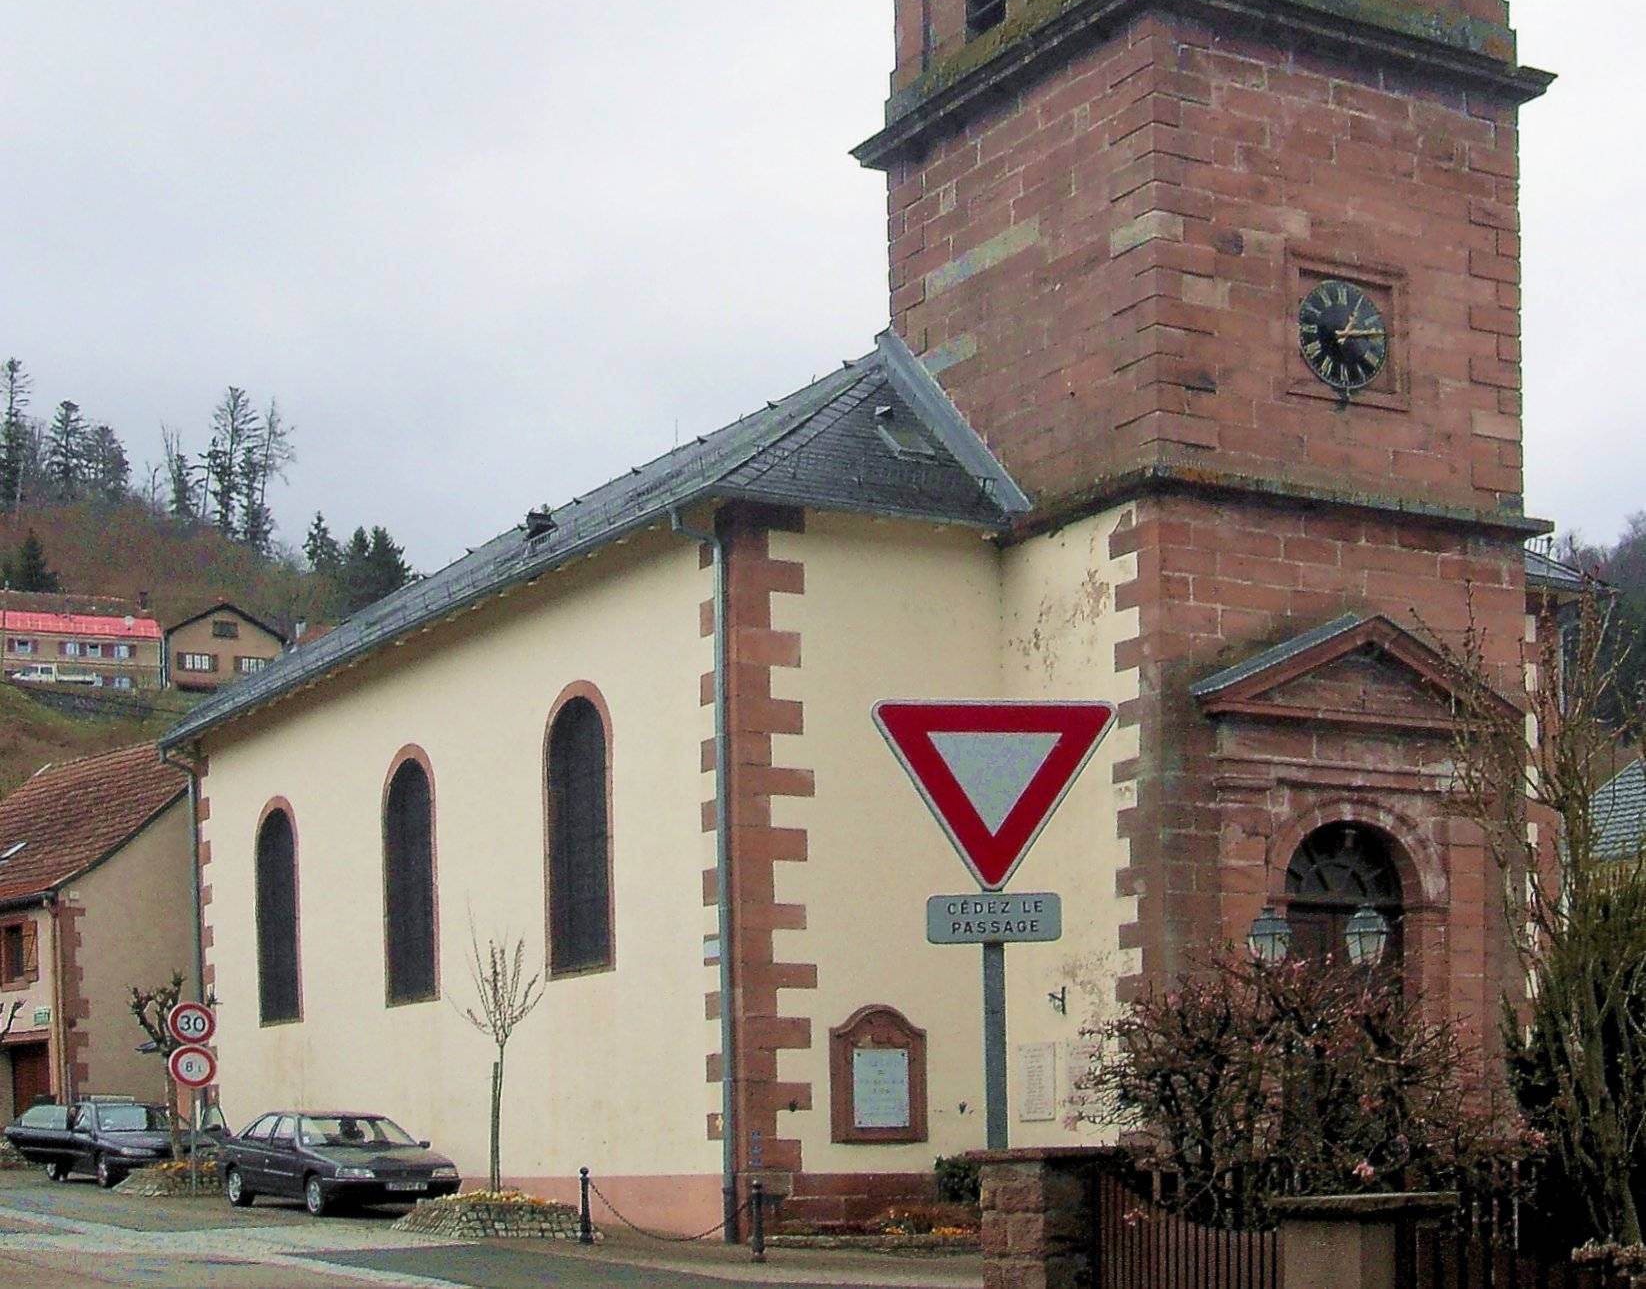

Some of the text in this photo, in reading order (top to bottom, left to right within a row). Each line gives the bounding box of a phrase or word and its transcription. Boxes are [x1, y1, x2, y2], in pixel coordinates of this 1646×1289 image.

[947, 900, 1043, 915] CÉDEZ LE
[951, 920, 1040, 935] PASSAGE
[180, 1015, 205, 1032] 30
